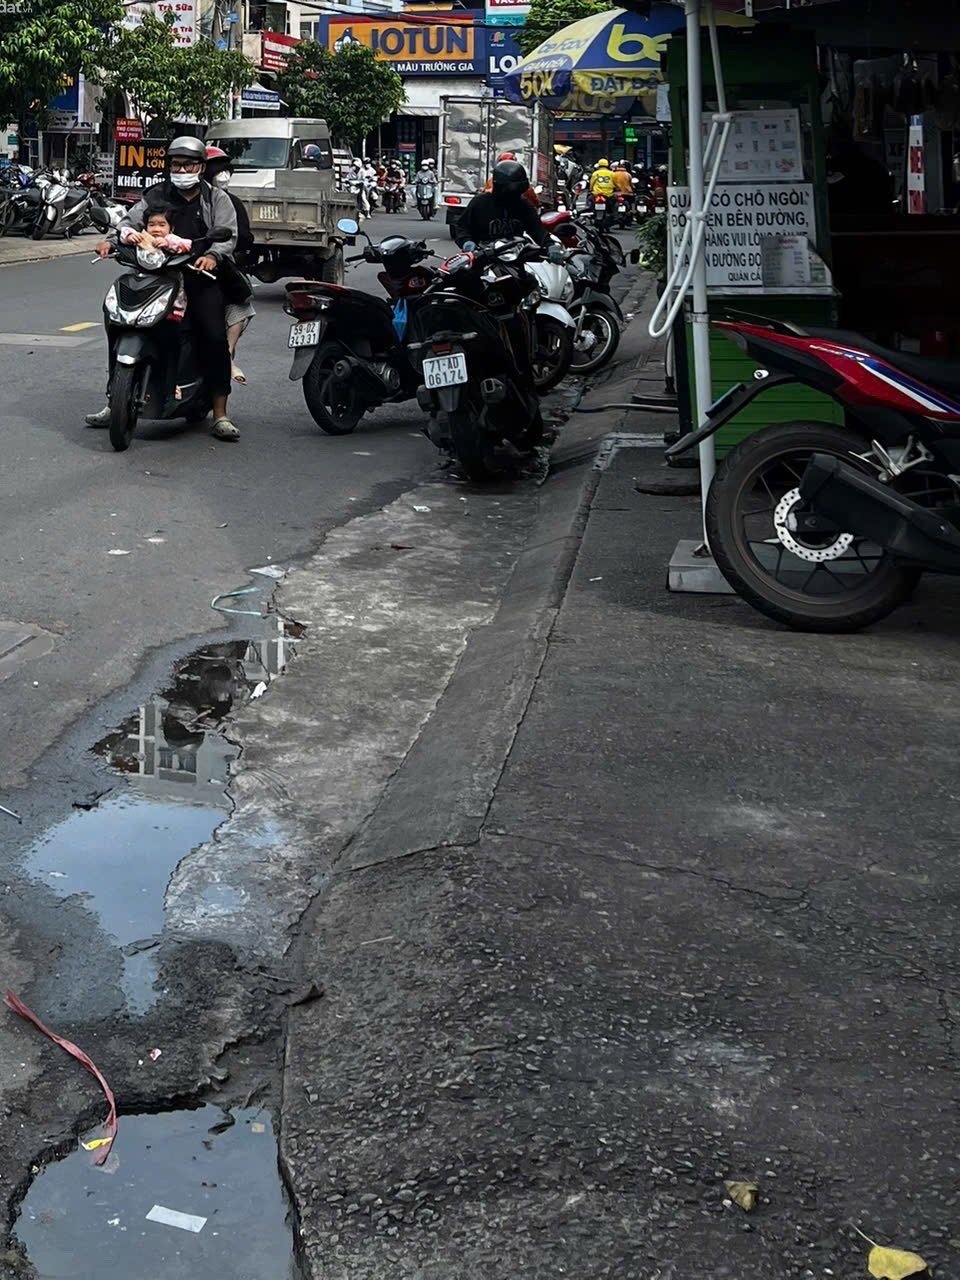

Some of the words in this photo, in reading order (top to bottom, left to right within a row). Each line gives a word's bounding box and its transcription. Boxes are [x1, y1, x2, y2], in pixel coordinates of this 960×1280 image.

[397, 61, 419, 72] MÀU
[420, 61, 456, 72] TRƯỜNG
[458, 62, 475, 71] GIA
[120, 145, 145, 168] IN
[117, 170, 144, 188] KHẮC
[711, 189, 731, 207] CÓ
[726, 208, 753, 227] BÊN
[731, 232, 747, 247] VUI
[712, 250, 747, 267] ĐƯỜNG
